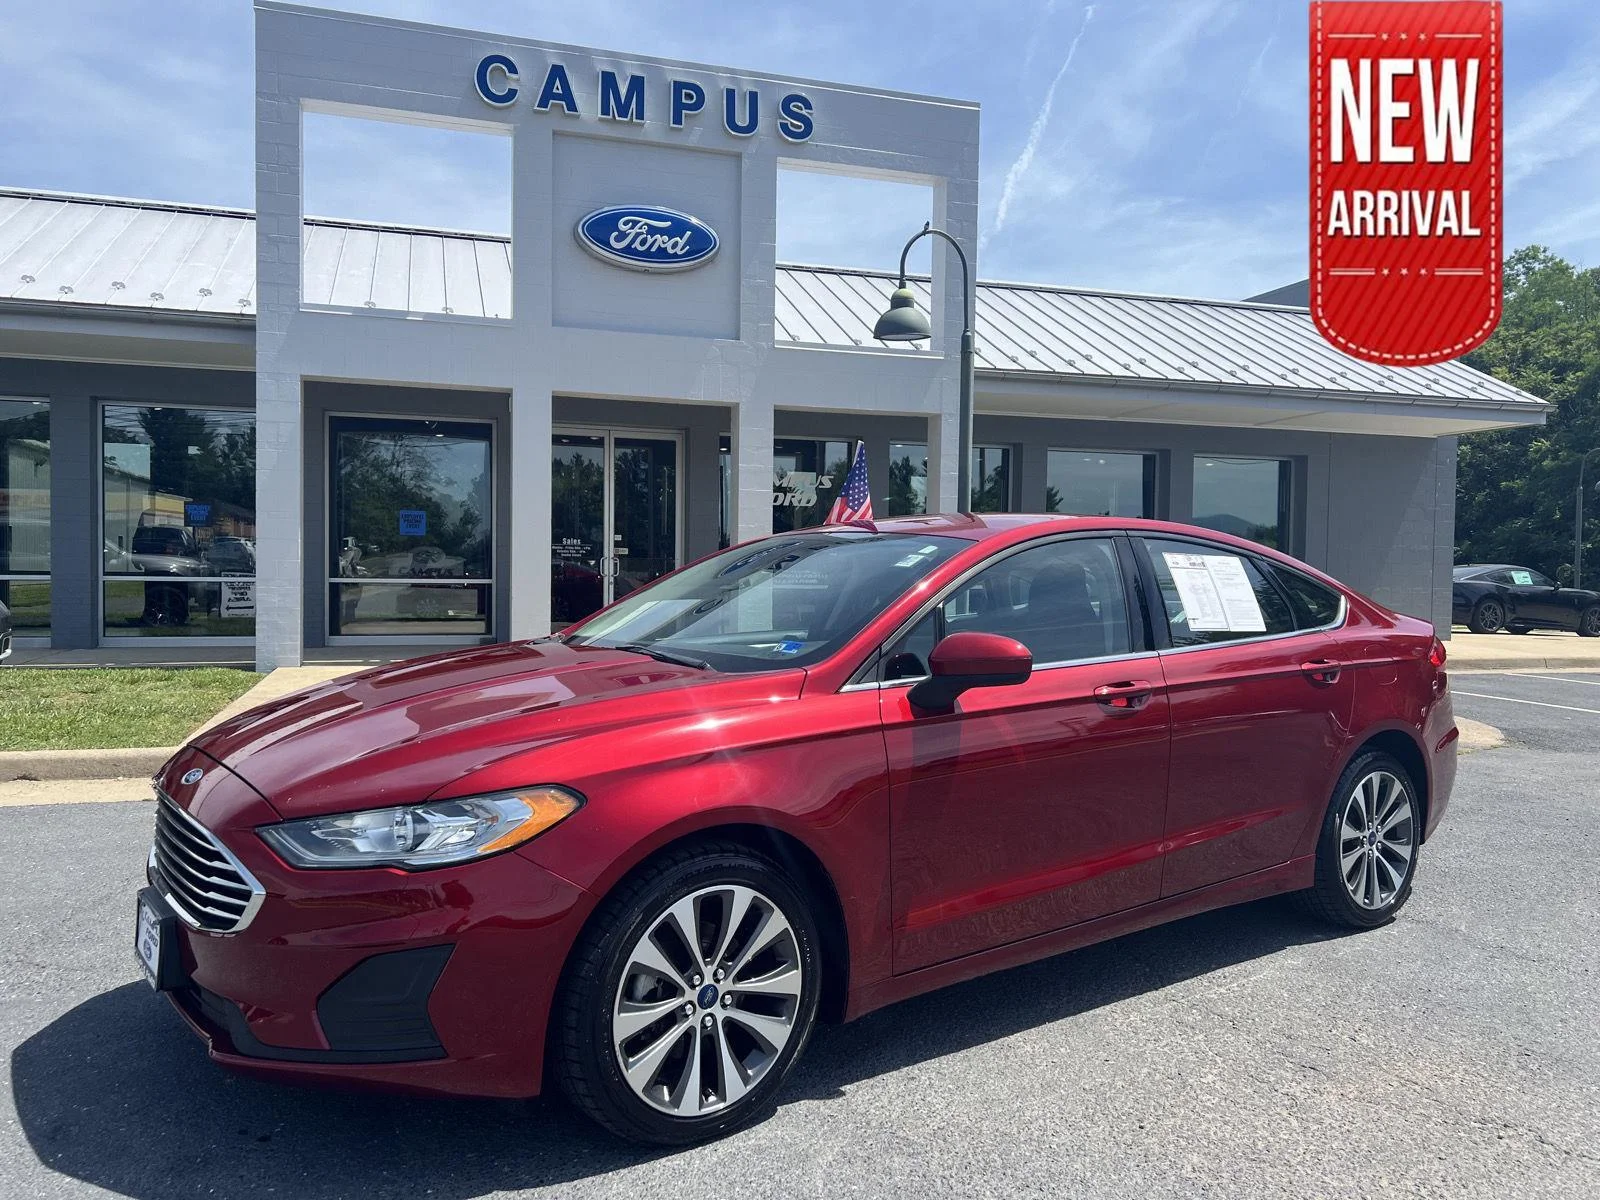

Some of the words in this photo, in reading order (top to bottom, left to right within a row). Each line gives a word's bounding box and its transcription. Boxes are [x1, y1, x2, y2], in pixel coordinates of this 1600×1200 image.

[474, 54, 814, 142] CAMPUS
[609, 216, 692, 255] Ford
[773, 492, 817, 506] ORD
[562, 537, 581, 545] Sales
